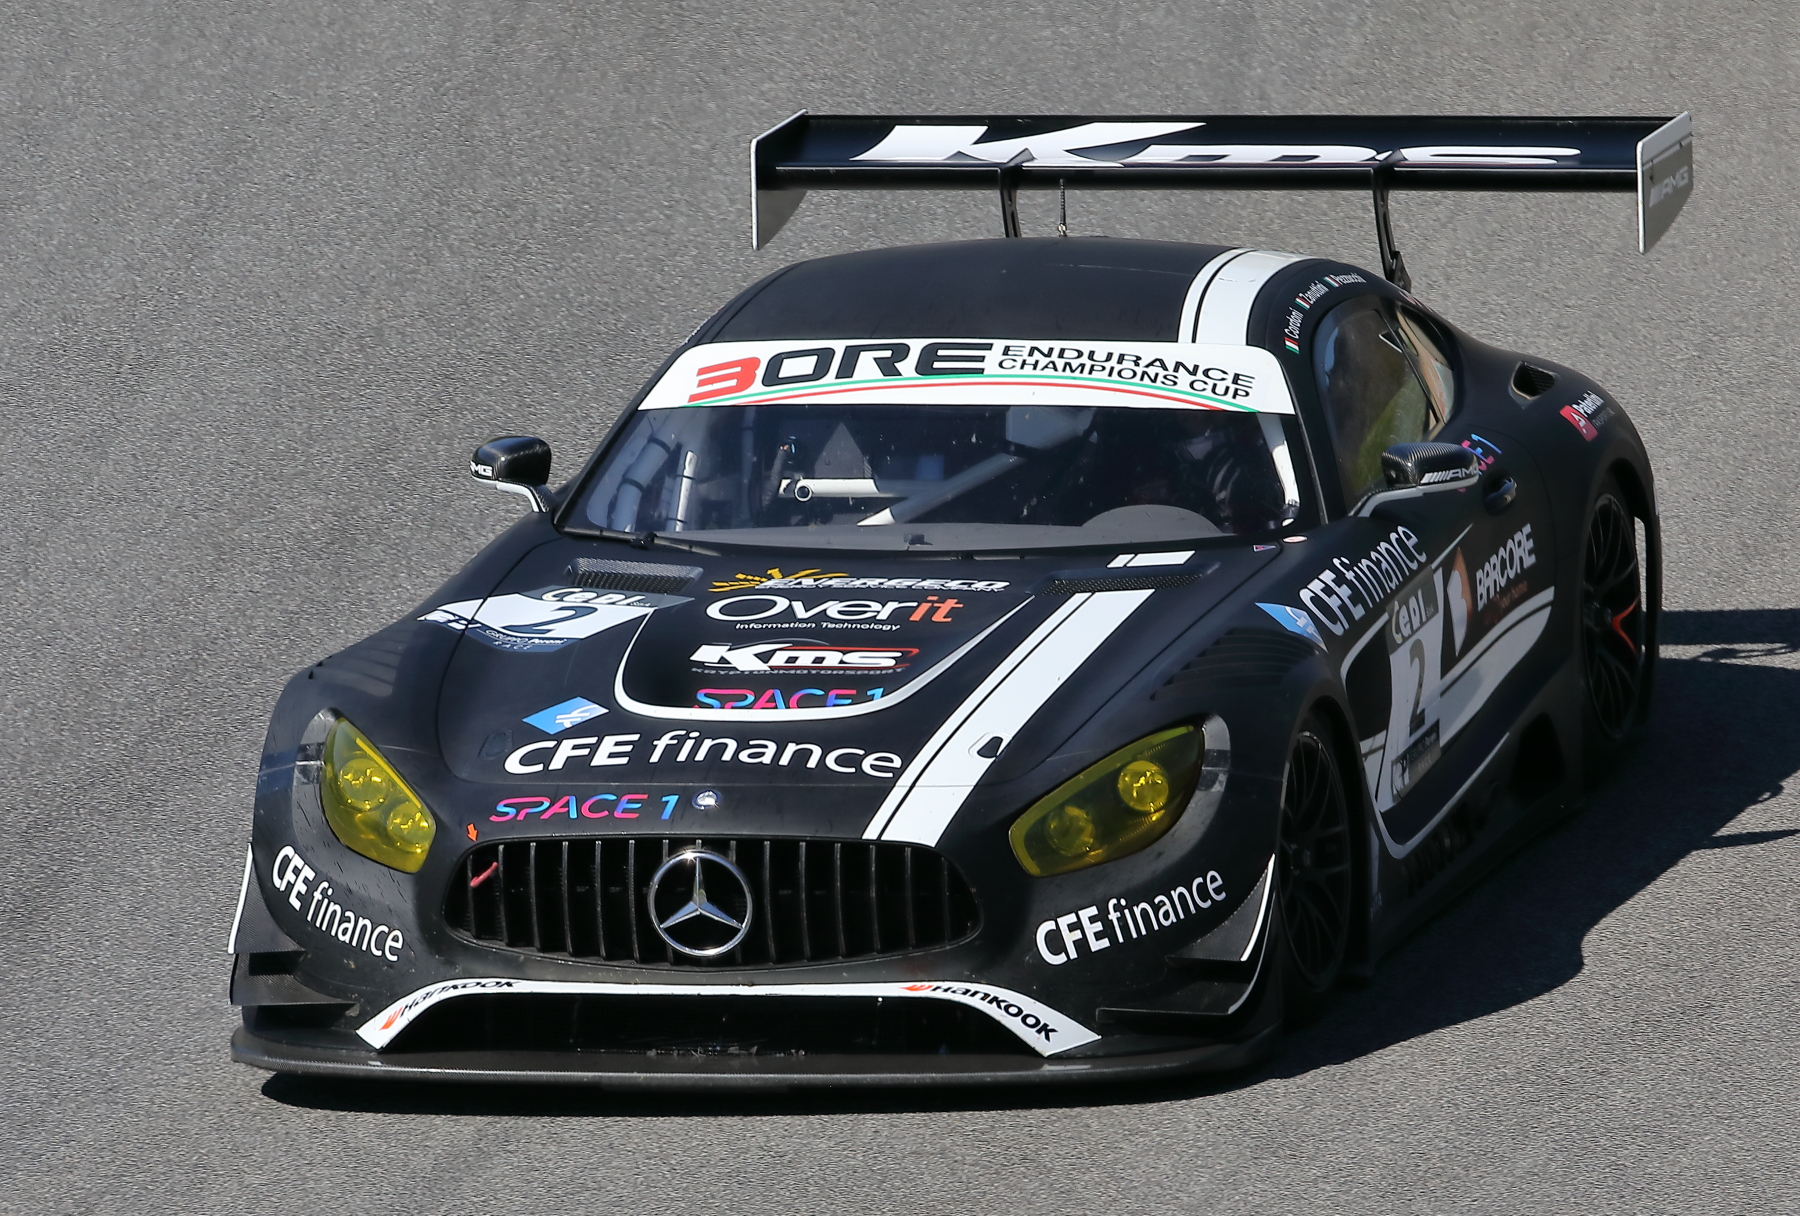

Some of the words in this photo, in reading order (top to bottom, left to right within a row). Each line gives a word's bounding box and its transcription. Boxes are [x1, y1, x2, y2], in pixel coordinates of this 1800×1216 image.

[998, 356, 1183, 391] CHAMPIONS
[1189, 376, 1252, 400] CUP
[1001, 344, 1255, 389] ENDURANCE
[760, 577, 1012, 590] ENERGECO
[1298, 568, 1366, 637] CFE
[1332, 524, 1428, 609] finance
[1475, 522, 1537, 612] BARCORE
[501, 605, 600, 635] 2
[705, 594, 965, 625] Overit
[735, 621, 816, 630] Information
[821, 622, 901, 632] Technology
[690, 642, 904, 671] Kms
[693, 688, 858, 710] SPACE
[1409, 637, 1426, 736] 2
[502, 732, 640, 776] CFE
[649, 729, 903, 778] finance
[488, 793, 649, 823] SPACE
[660, 793, 680, 821] 1
[271, 844, 316, 912] CFE
[306, 880, 405, 963] finance
[1036, 905, 1111, 966] CFE
[1107, 869, 1228, 944] finance
